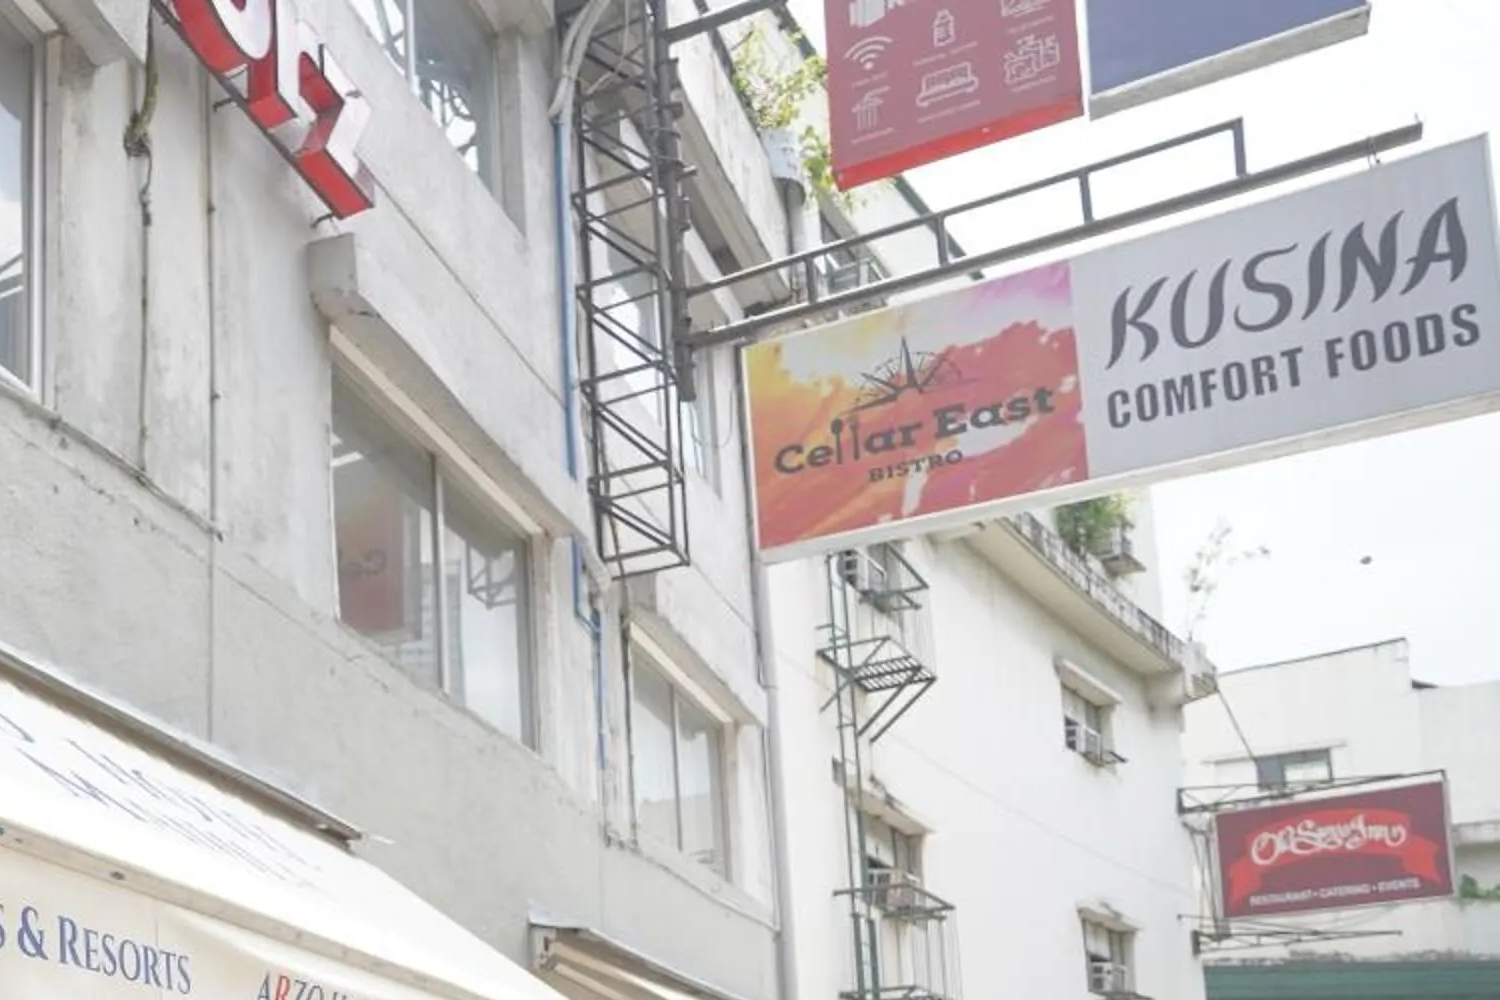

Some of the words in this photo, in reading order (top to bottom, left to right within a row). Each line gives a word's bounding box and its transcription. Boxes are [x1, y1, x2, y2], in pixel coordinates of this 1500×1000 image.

[1106, 196, 1468, 370] KUSINA
[1108, 346, 1304, 428] COMFORT
[1324, 303, 1480, 379] FOODS
[774, 414, 923, 475] Cellar
[932, 387, 1056, 440] East
[868, 448, 965, 484] BISTRO
[16, 906, 49, 961] &
[58, 915, 193, 995] RESORTS
